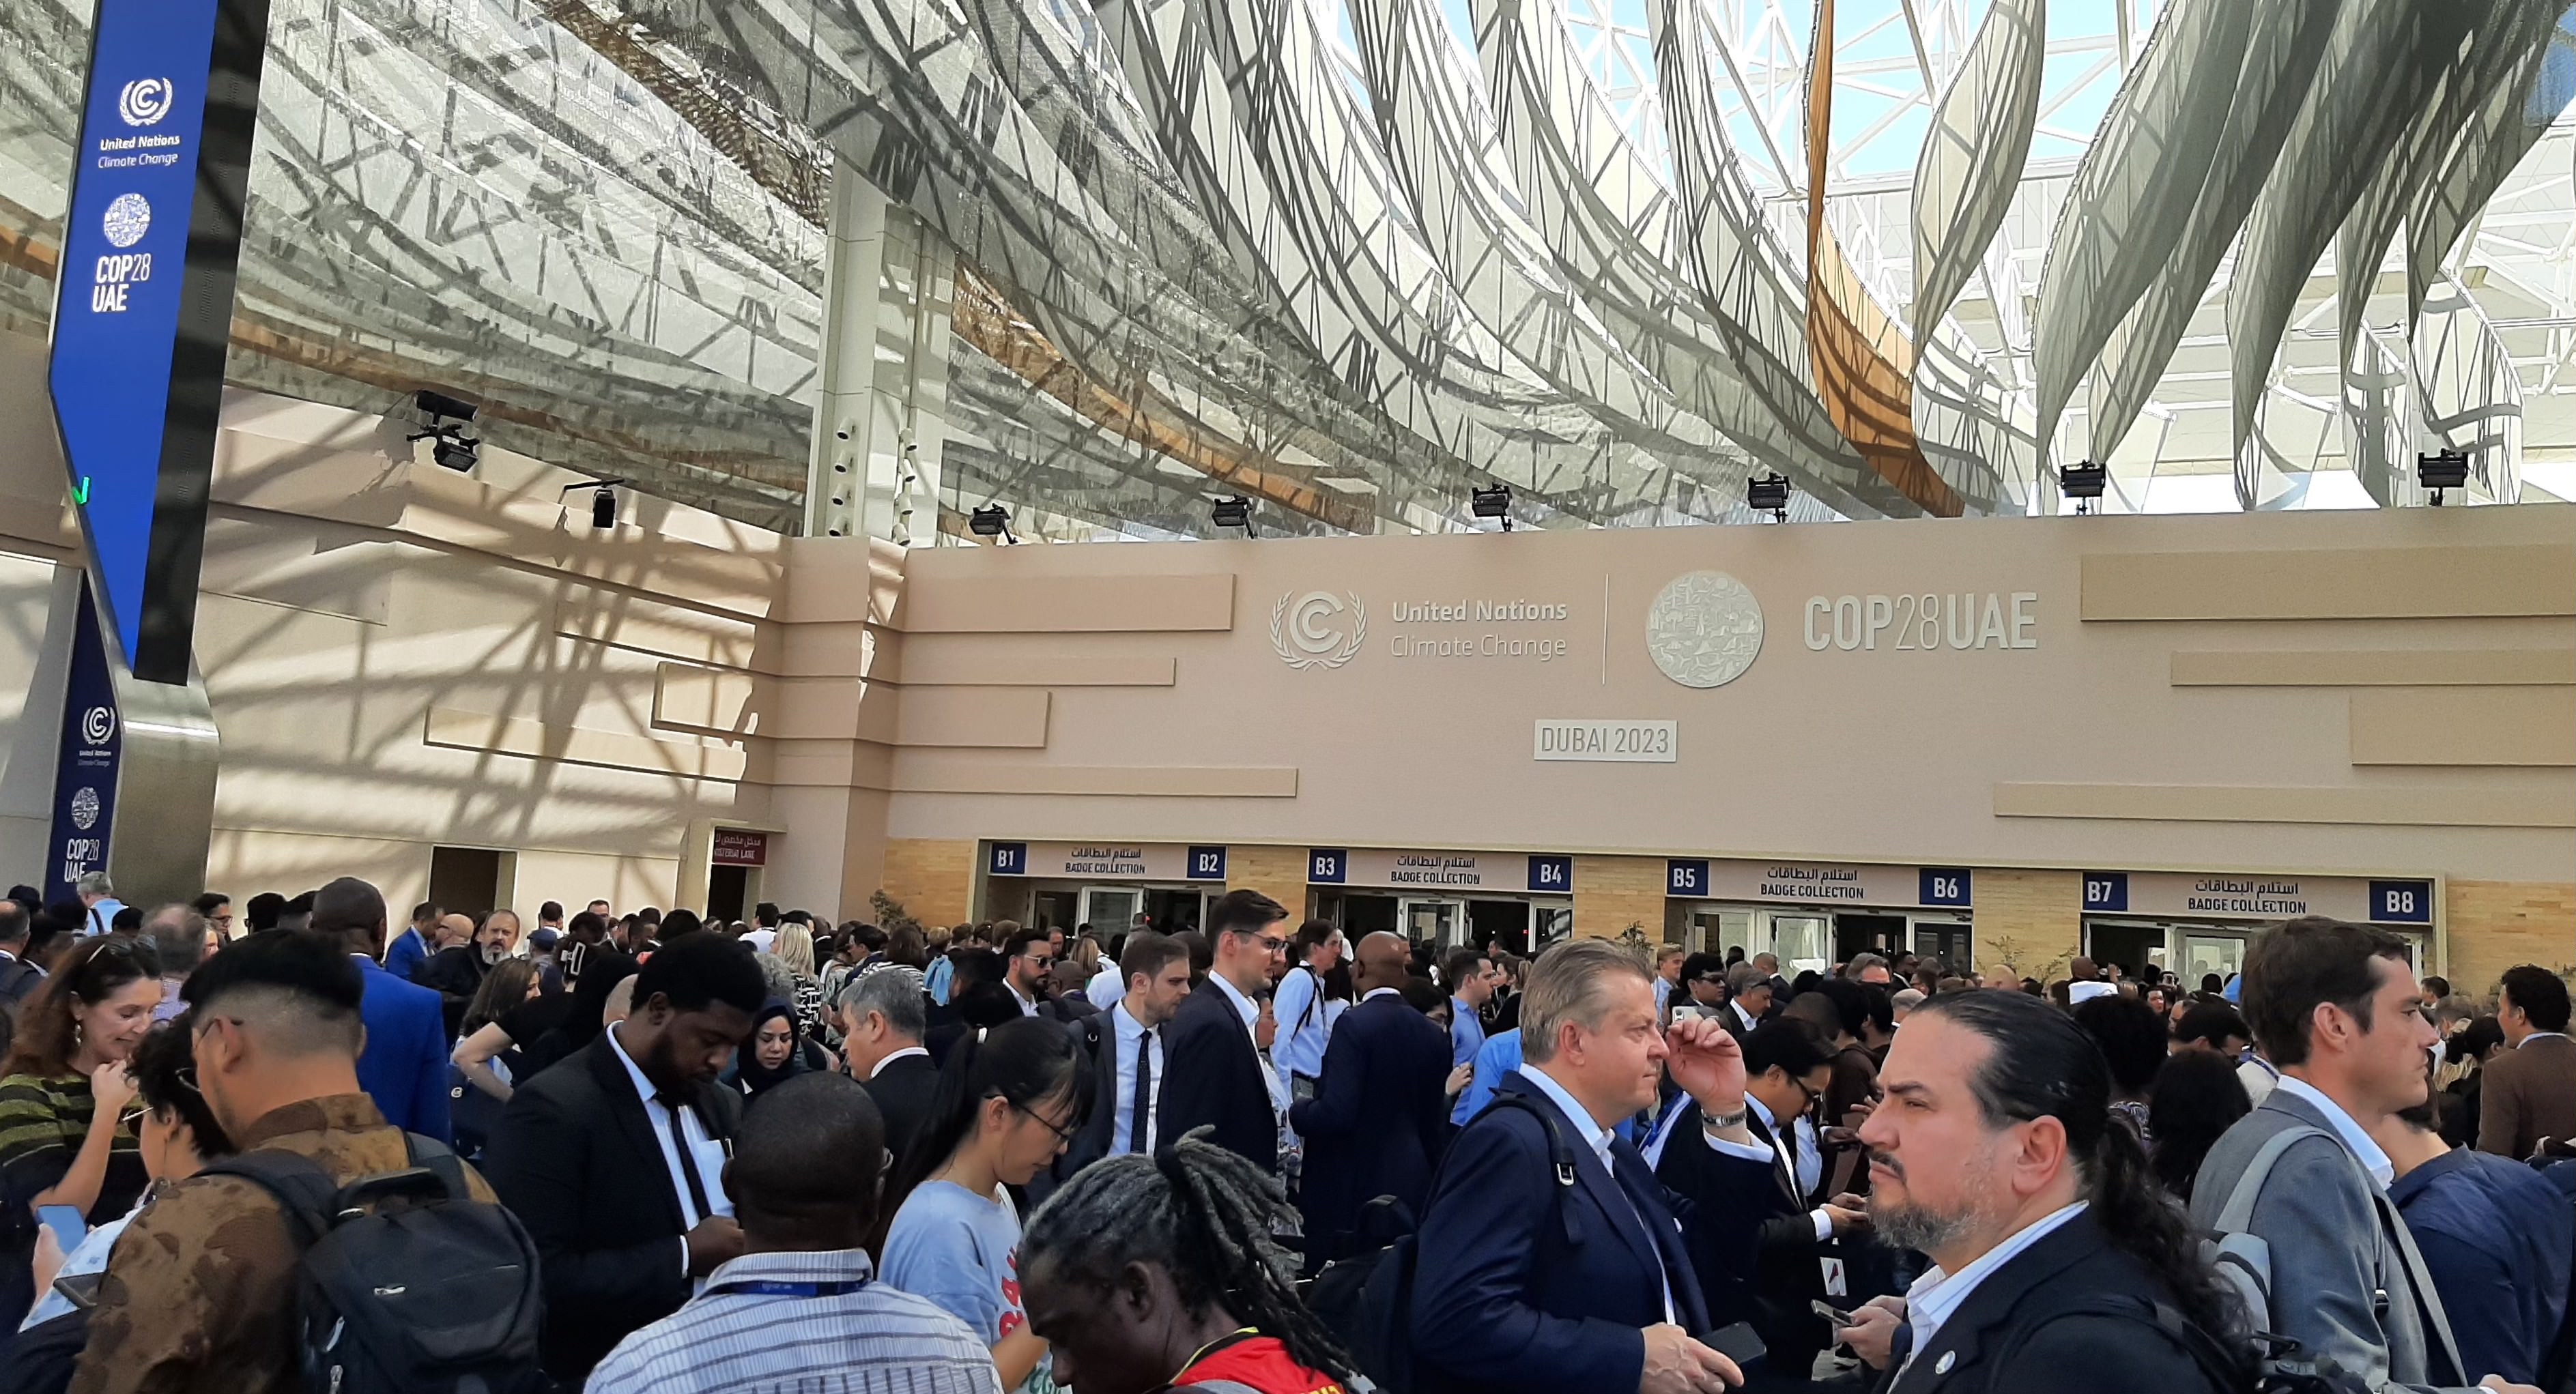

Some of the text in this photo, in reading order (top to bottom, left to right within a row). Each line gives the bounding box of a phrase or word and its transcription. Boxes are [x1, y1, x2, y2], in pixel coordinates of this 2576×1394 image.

[100, 134, 180, 151] United Nations
[98, 154, 178, 169] Climate Change
[96, 253, 151, 283] COP28
[92, 284, 129, 313] UAE
[1392, 598, 1568, 622] United Nations
[1391, 634, 1566, 662] Climate Change
[1541, 727, 1670, 753] DUBAI 2023
[998, 850, 1014, 867] B1
[1199, 854, 1218, 871] B2
[1316, 857, 1334, 875] B3
[1391, 871, 1480, 884] BADGE COLLECTION
[1541, 864, 1562, 884] B4
[1673, 868, 1695, 888] B5
[1767, 867, 1857, 884] استلام البطاقات
[1761, 884, 1863, 899] BADGE COLLECTION
[1934, 877, 1958, 898] B6
[2087, 882, 2112, 902] B7
[2195, 880, 2298, 899] استلام البطاقات
[2188, 897, 2306, 914] BADGE COLLECTION
[2386, 891, 2414, 914] B8
